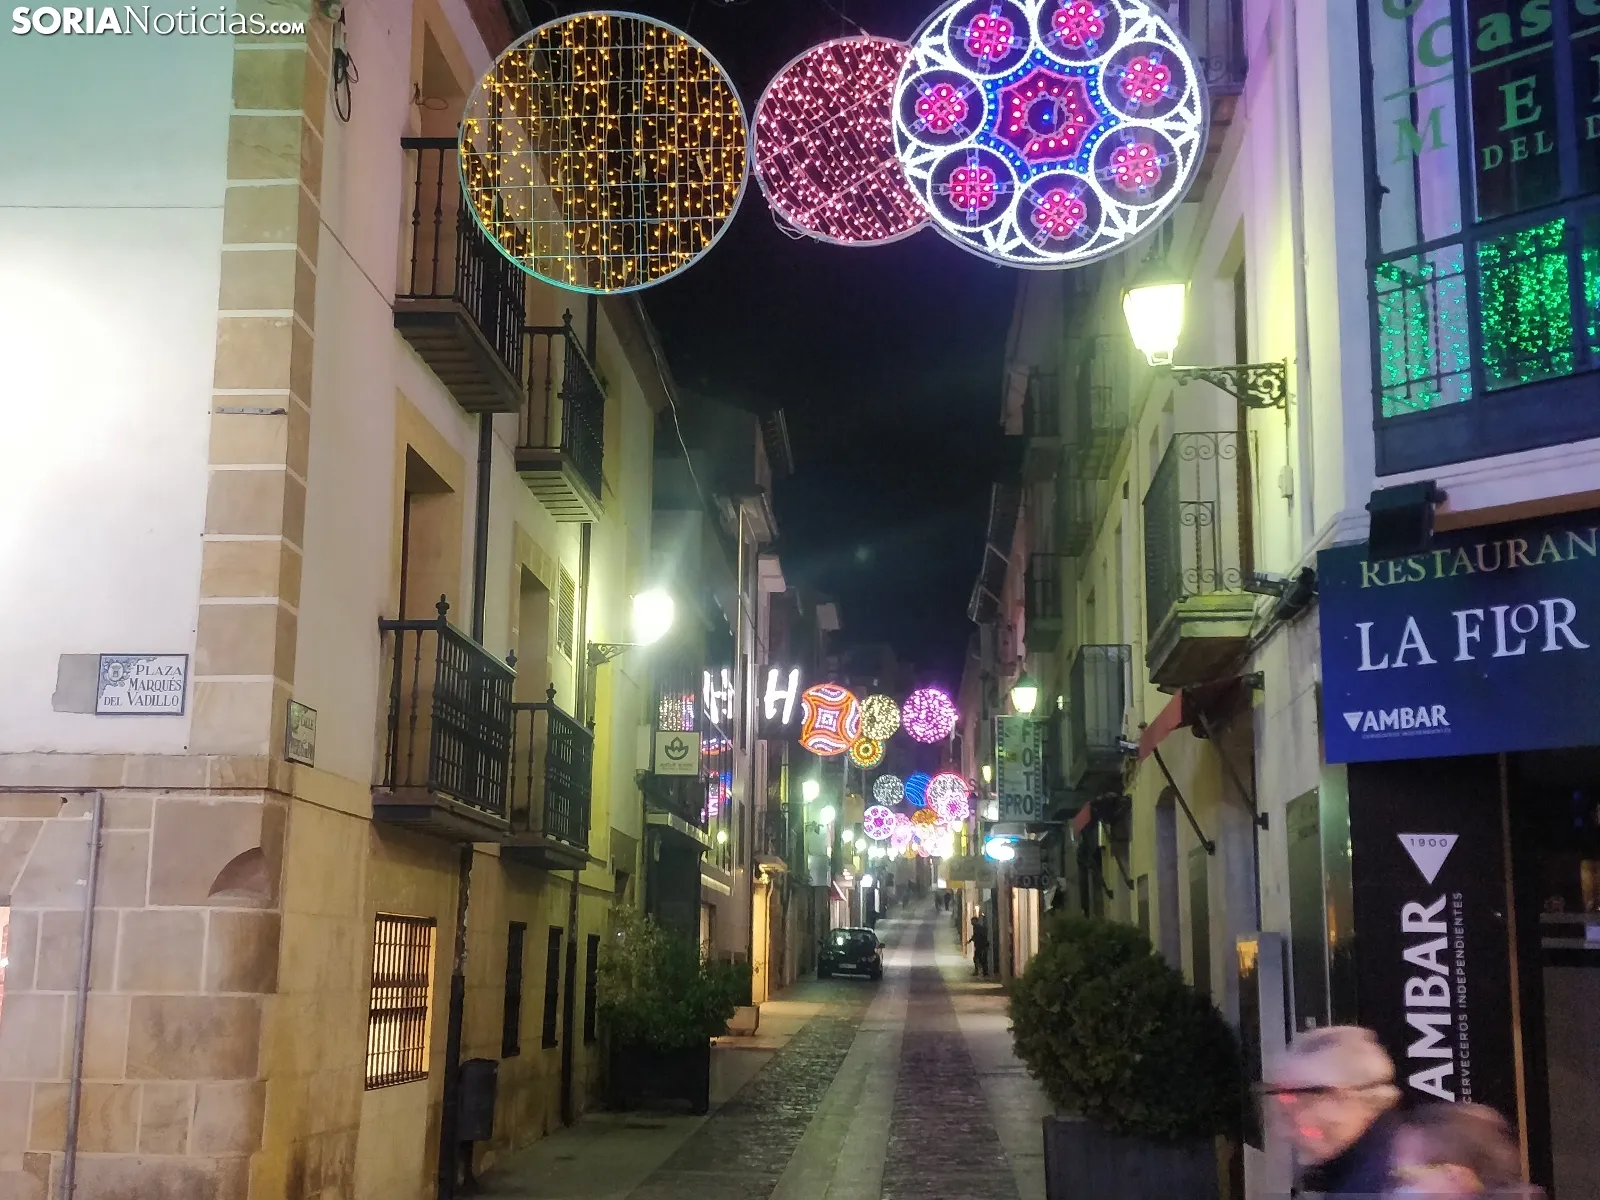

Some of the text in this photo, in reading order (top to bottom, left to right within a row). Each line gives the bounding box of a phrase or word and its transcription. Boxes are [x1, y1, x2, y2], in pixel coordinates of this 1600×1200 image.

[1482, 130, 1554, 171] DEL
[1354, 596, 1591, 672] LA FLOR
[136, 664, 183, 677] PLAZA
[128, 677, 182, 692] MARQUÉS
[103, 691, 180, 707] DEL VADILLO
[1362, 704, 1451, 732] AMBAR
[1005, 792, 1035, 815] PRO
[1410, 838, 1448, 848] 1900
[1402, 892, 1456, 1103] AMBAR
[1452, 891, 1473, 1105] CERVECEROS INDEPENDIENTES
